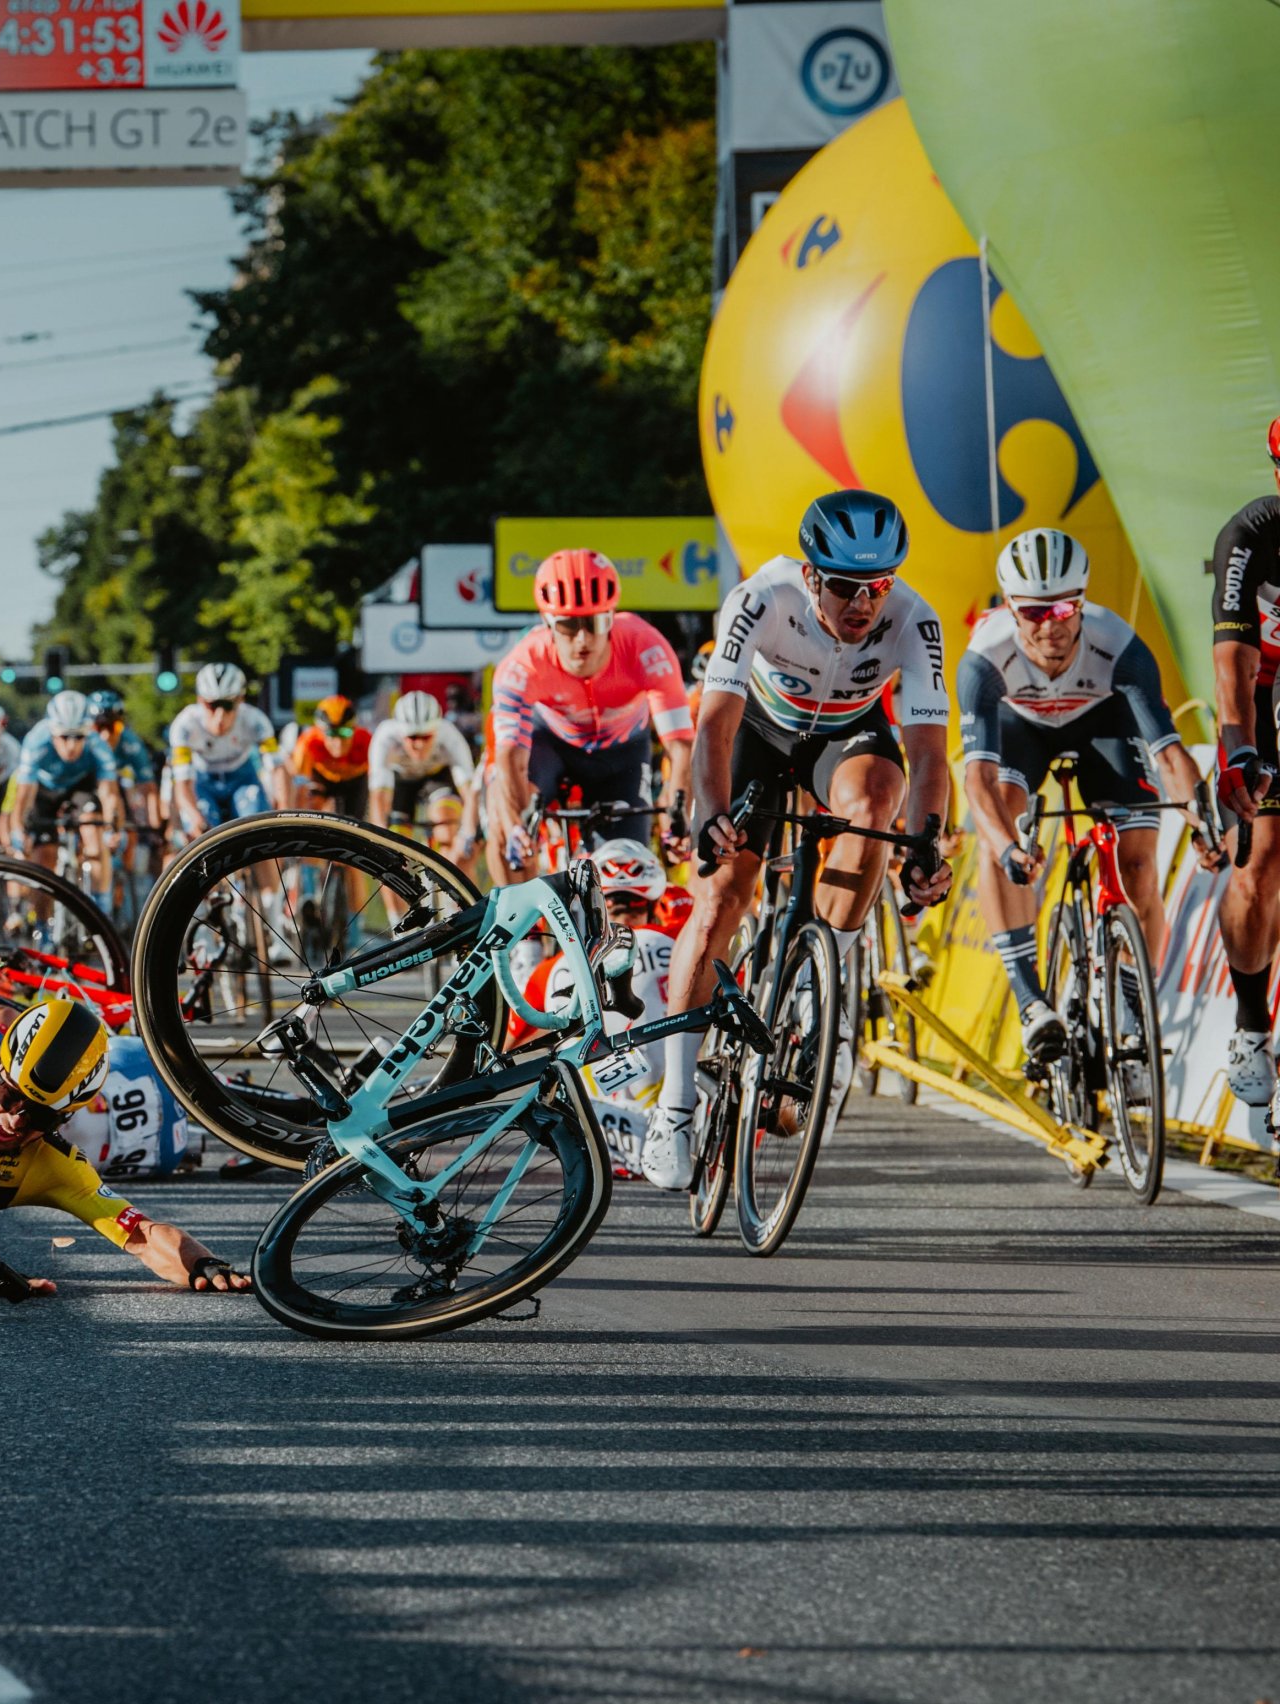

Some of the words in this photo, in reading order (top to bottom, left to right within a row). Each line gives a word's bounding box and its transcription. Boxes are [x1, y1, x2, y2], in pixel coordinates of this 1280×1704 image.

[154, 60, 233, 78] HUAWEI
[109, 107, 168, 151] GT
[186, 106, 239, 149] 2e
[854, 552, 878, 561] GIRO
[1222, 546, 1251, 612] SOUDAL
[721, 592, 767, 664] BMC
[916, 619, 948, 694] BMC
[829, 683, 881, 700] NT
[359, 948, 434, 987] Bianchi
[380, 924, 515, 1080] Bianchi
[642, 1013, 689, 1034] Bianchi
[14, 1011, 47, 1067] LAZER
[112, 1088, 148, 1132] 96
